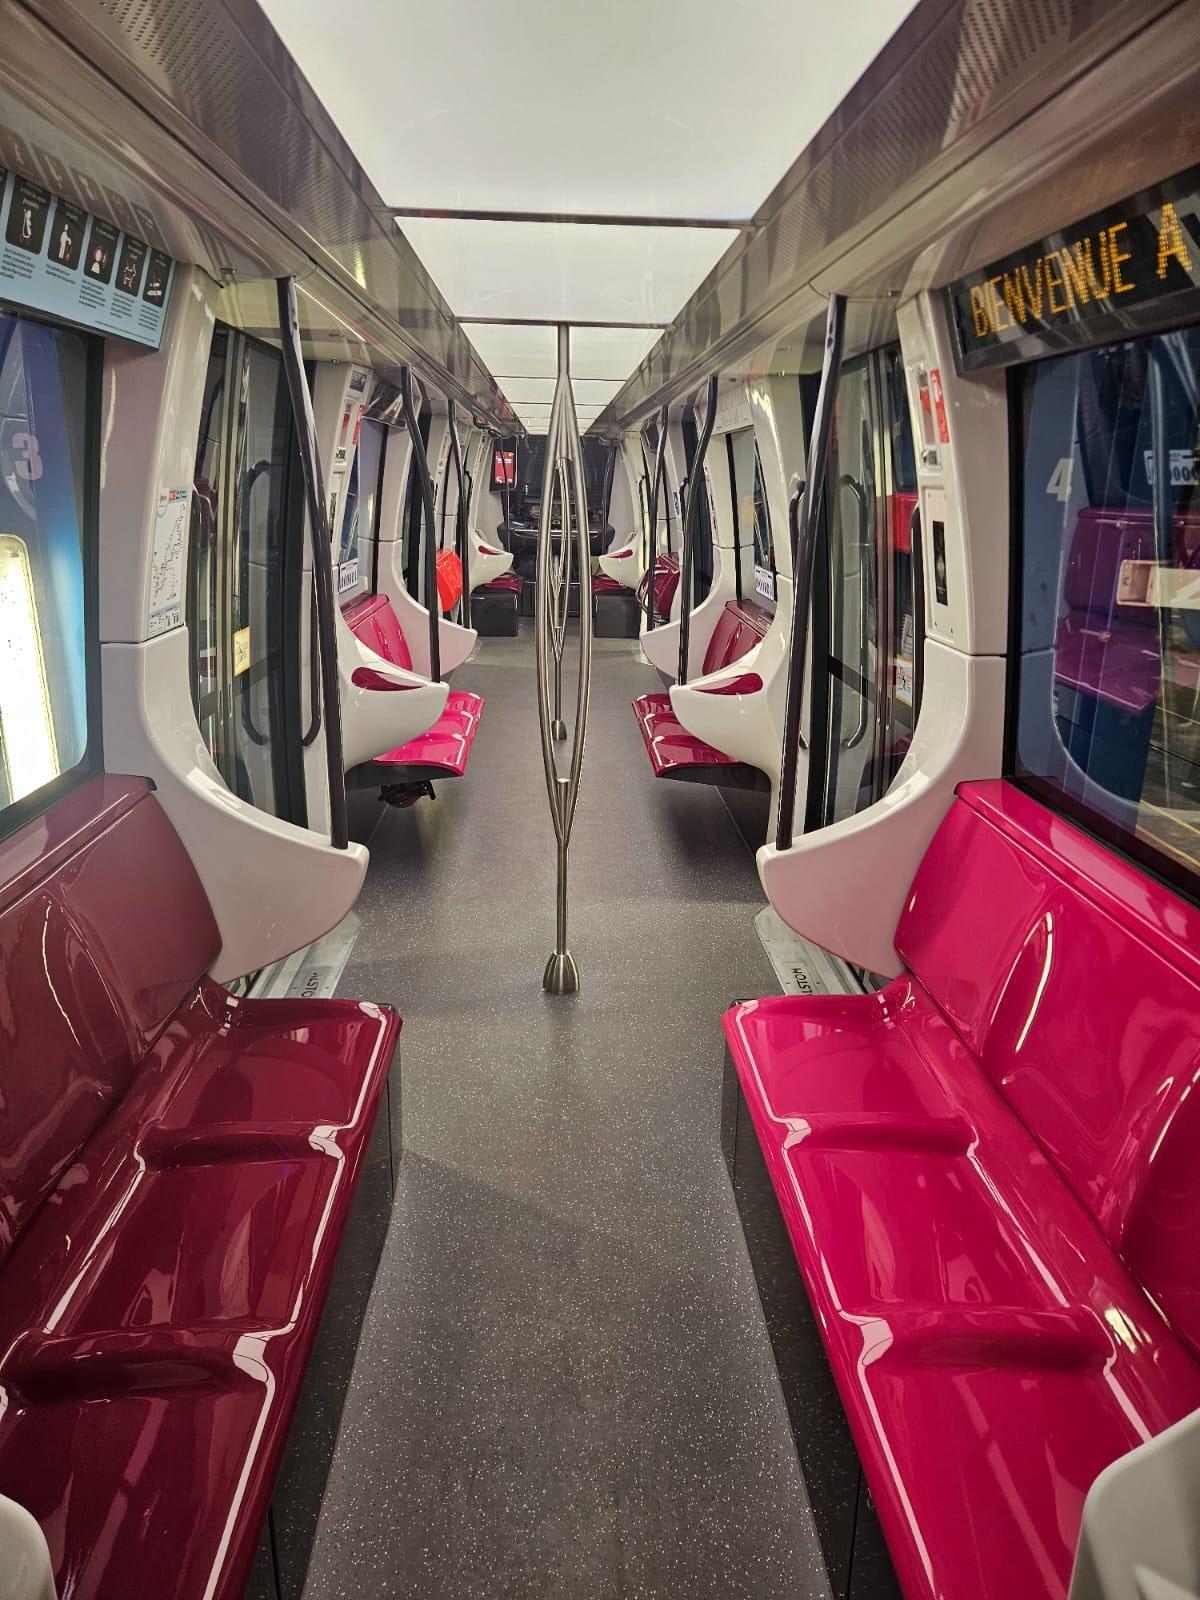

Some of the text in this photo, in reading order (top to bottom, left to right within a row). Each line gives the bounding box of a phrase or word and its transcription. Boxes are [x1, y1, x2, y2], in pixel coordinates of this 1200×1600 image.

[970, 203, 1193, 337] BIENVENUE A
[12, 432, 44, 481] 3
[1045, 458, 1074, 502] 4
